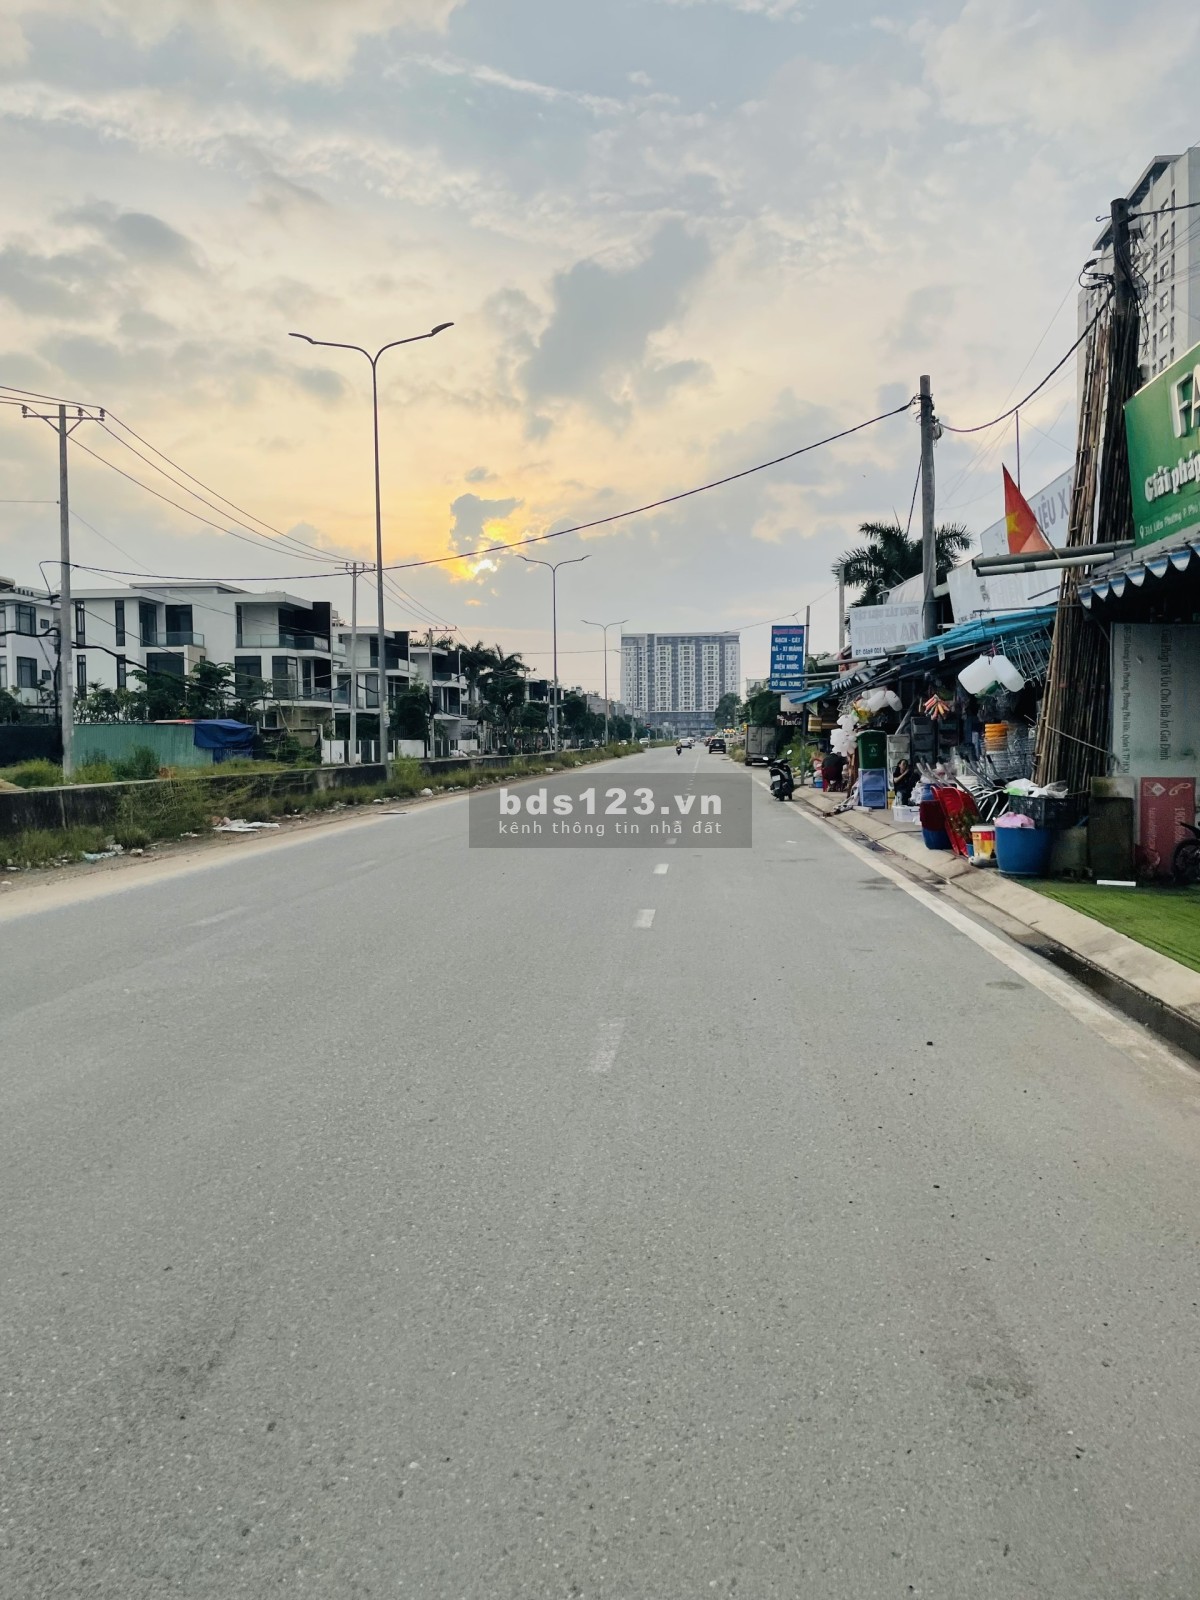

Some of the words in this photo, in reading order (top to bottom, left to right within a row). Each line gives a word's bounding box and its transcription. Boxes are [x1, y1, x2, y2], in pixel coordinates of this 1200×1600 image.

[1144, 465, 1172, 502] Giải
[1033, 495, 1056, 536] IỆU
[1160, 688, 1172, 703] Cho
